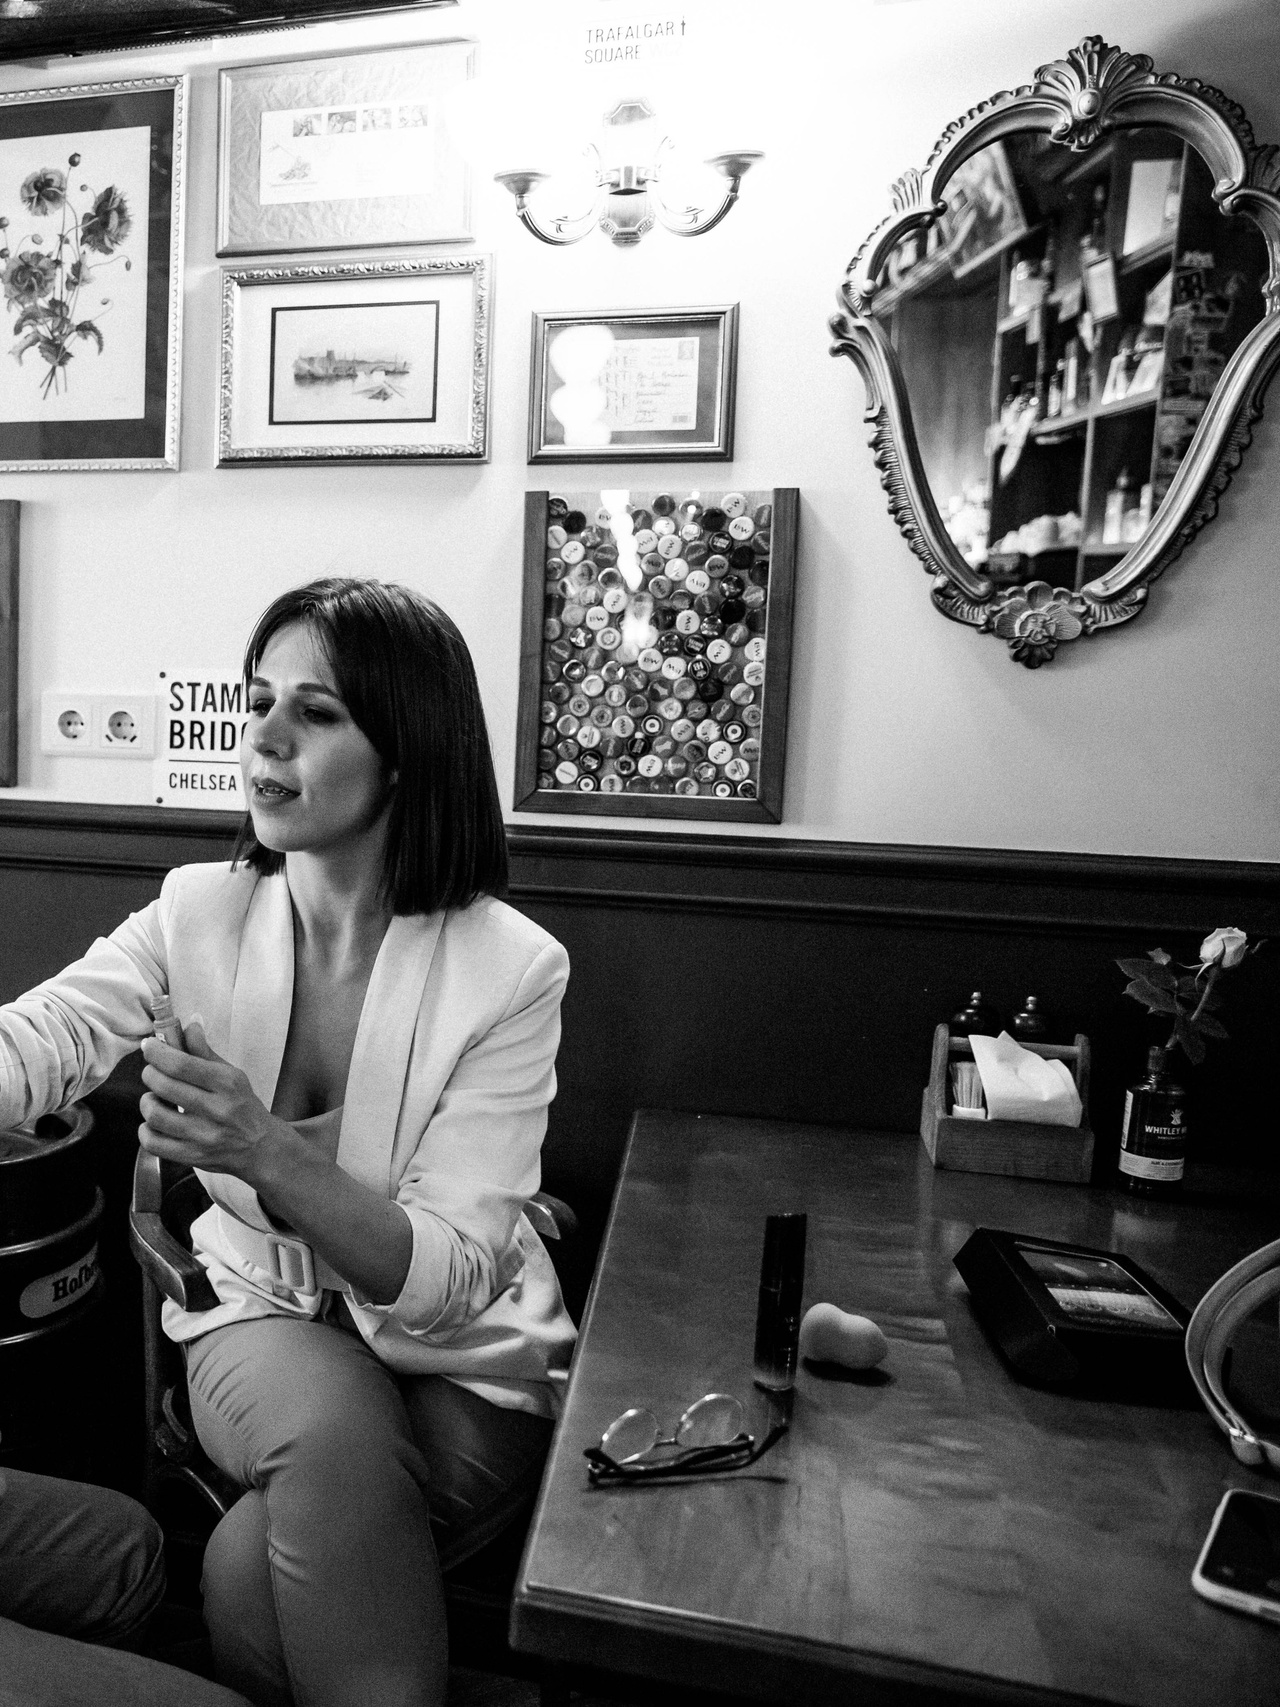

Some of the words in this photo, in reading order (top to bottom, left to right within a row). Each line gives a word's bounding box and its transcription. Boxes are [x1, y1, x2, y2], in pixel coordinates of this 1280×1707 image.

[586, 21, 675, 43] TRAFALGAR
[584, 44, 641, 64] SQUARE
[169, 772, 237, 791] CHELSEA
[1144, 1125, 1181, 1136] WHITLEY
[52, 1263, 94, 1302] Hofb
